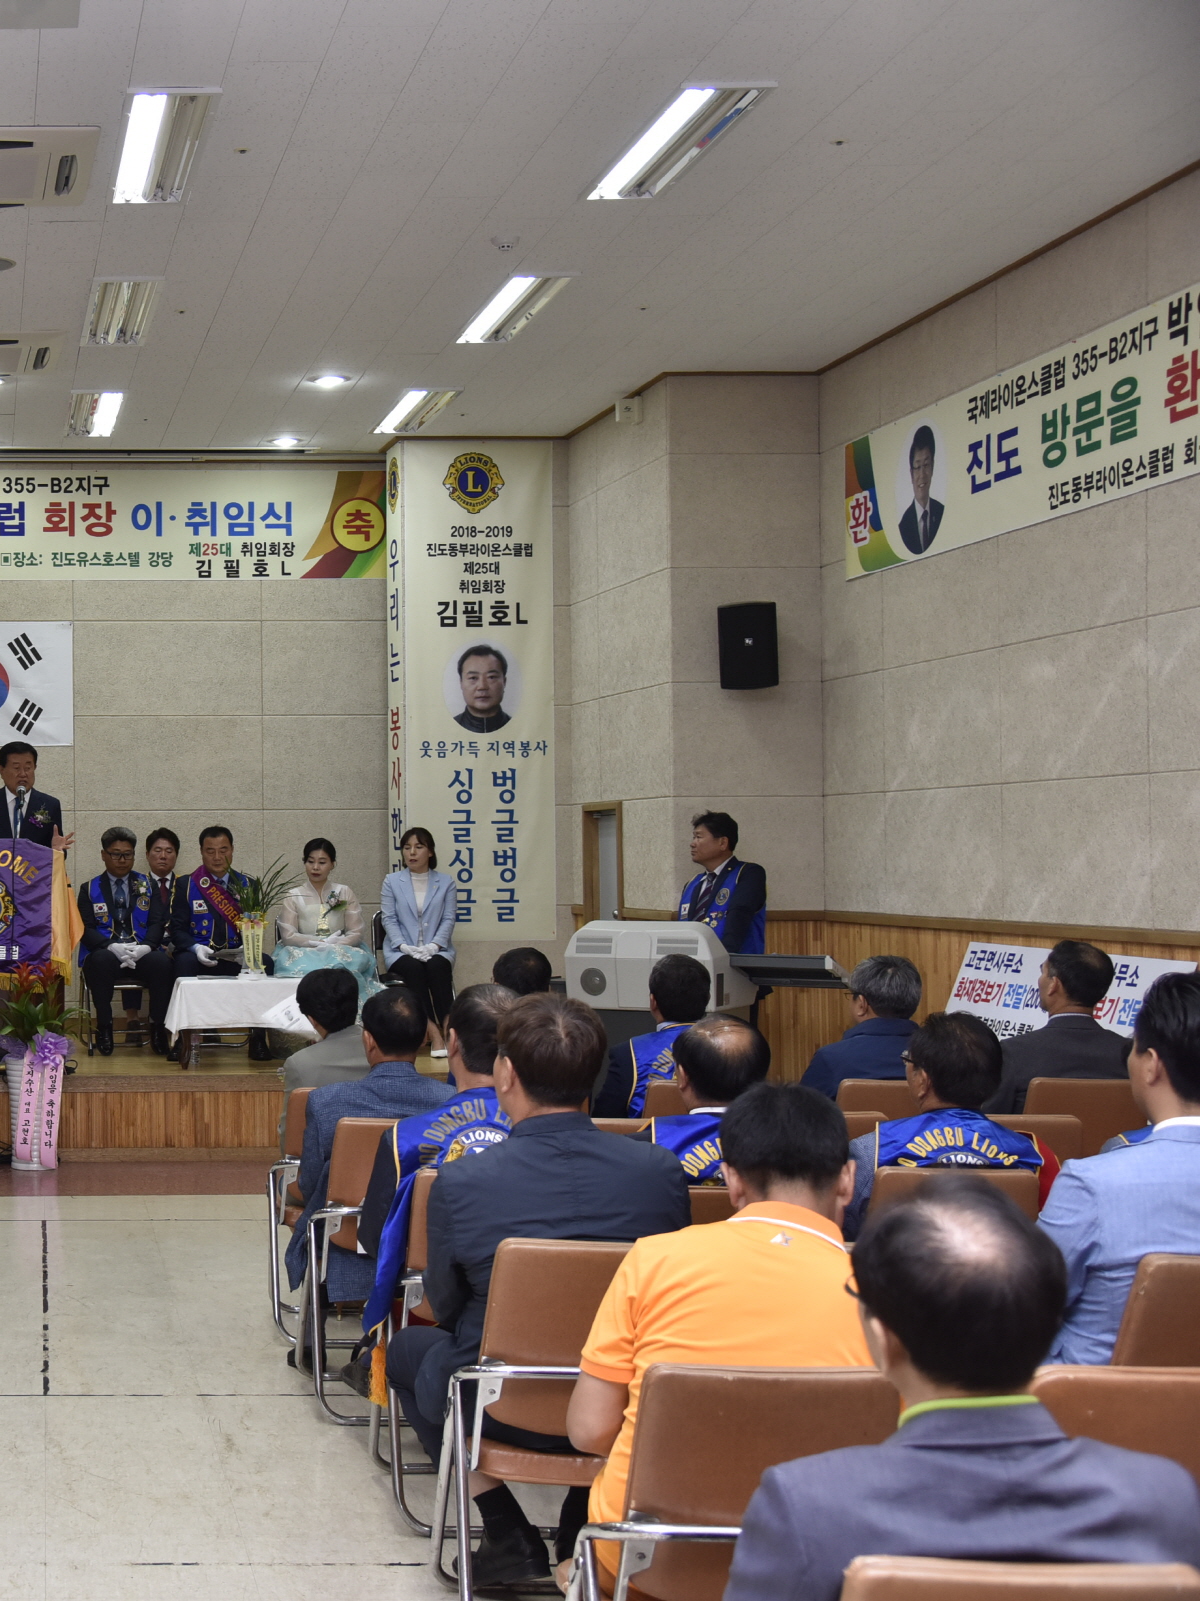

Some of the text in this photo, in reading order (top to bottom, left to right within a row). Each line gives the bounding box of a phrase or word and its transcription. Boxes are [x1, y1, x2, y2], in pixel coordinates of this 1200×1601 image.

[967, 292, 1200, 425] 국제라이온스클럽 355-B2지구 박
[966, 426, 1023, 495] 진도
[1040, 376, 1142, 468] 방문을
[457, 456, 490, 467] LIONS
[1048, 435, 1200, 511] 진도동부라이온스클럽 회
[2, 474, 110, 496] 355-B2지구
[465, 471, 483, 492] L
[455, 494, 494, 508] INTERNATIONAL
[42, 500, 117, 537] 회장
[131, 500, 294, 537] 이·취임식
[342, 508, 375, 542] 축
[450, 525, 513, 538] 2018-2019
[850, 495, 871, 544] 환
[13, 551, 174, 568] 장소: 진도유스호스텔 강당
[188, 541, 296, 557] 제25대 취임회장
[426, 543, 533, 558] 진도동부라이온스클럽
[463, 561, 500, 575] 제25대
[459, 579, 506, 594] 취임회장
[436, 600, 529, 627] 김필호L
[419, 740, 548, 759] 웃음가득 지역봉사
[389, 706, 402, 872] 봉사한
[206, 886, 243, 925] PRESIDEN
[964, 950, 1025, 974] 고군면사무소
[1112, 962, 1141, 988] 무소
[953, 976, 1007, 1007] 화재경보기
[43, 1098, 56, 1150] 축하합니다
[422, 1098, 487, 1142] DONGBU
[460, 1130, 504, 1144] LIONS
[906, 1126, 1019, 1166] DONGBU LIONS
